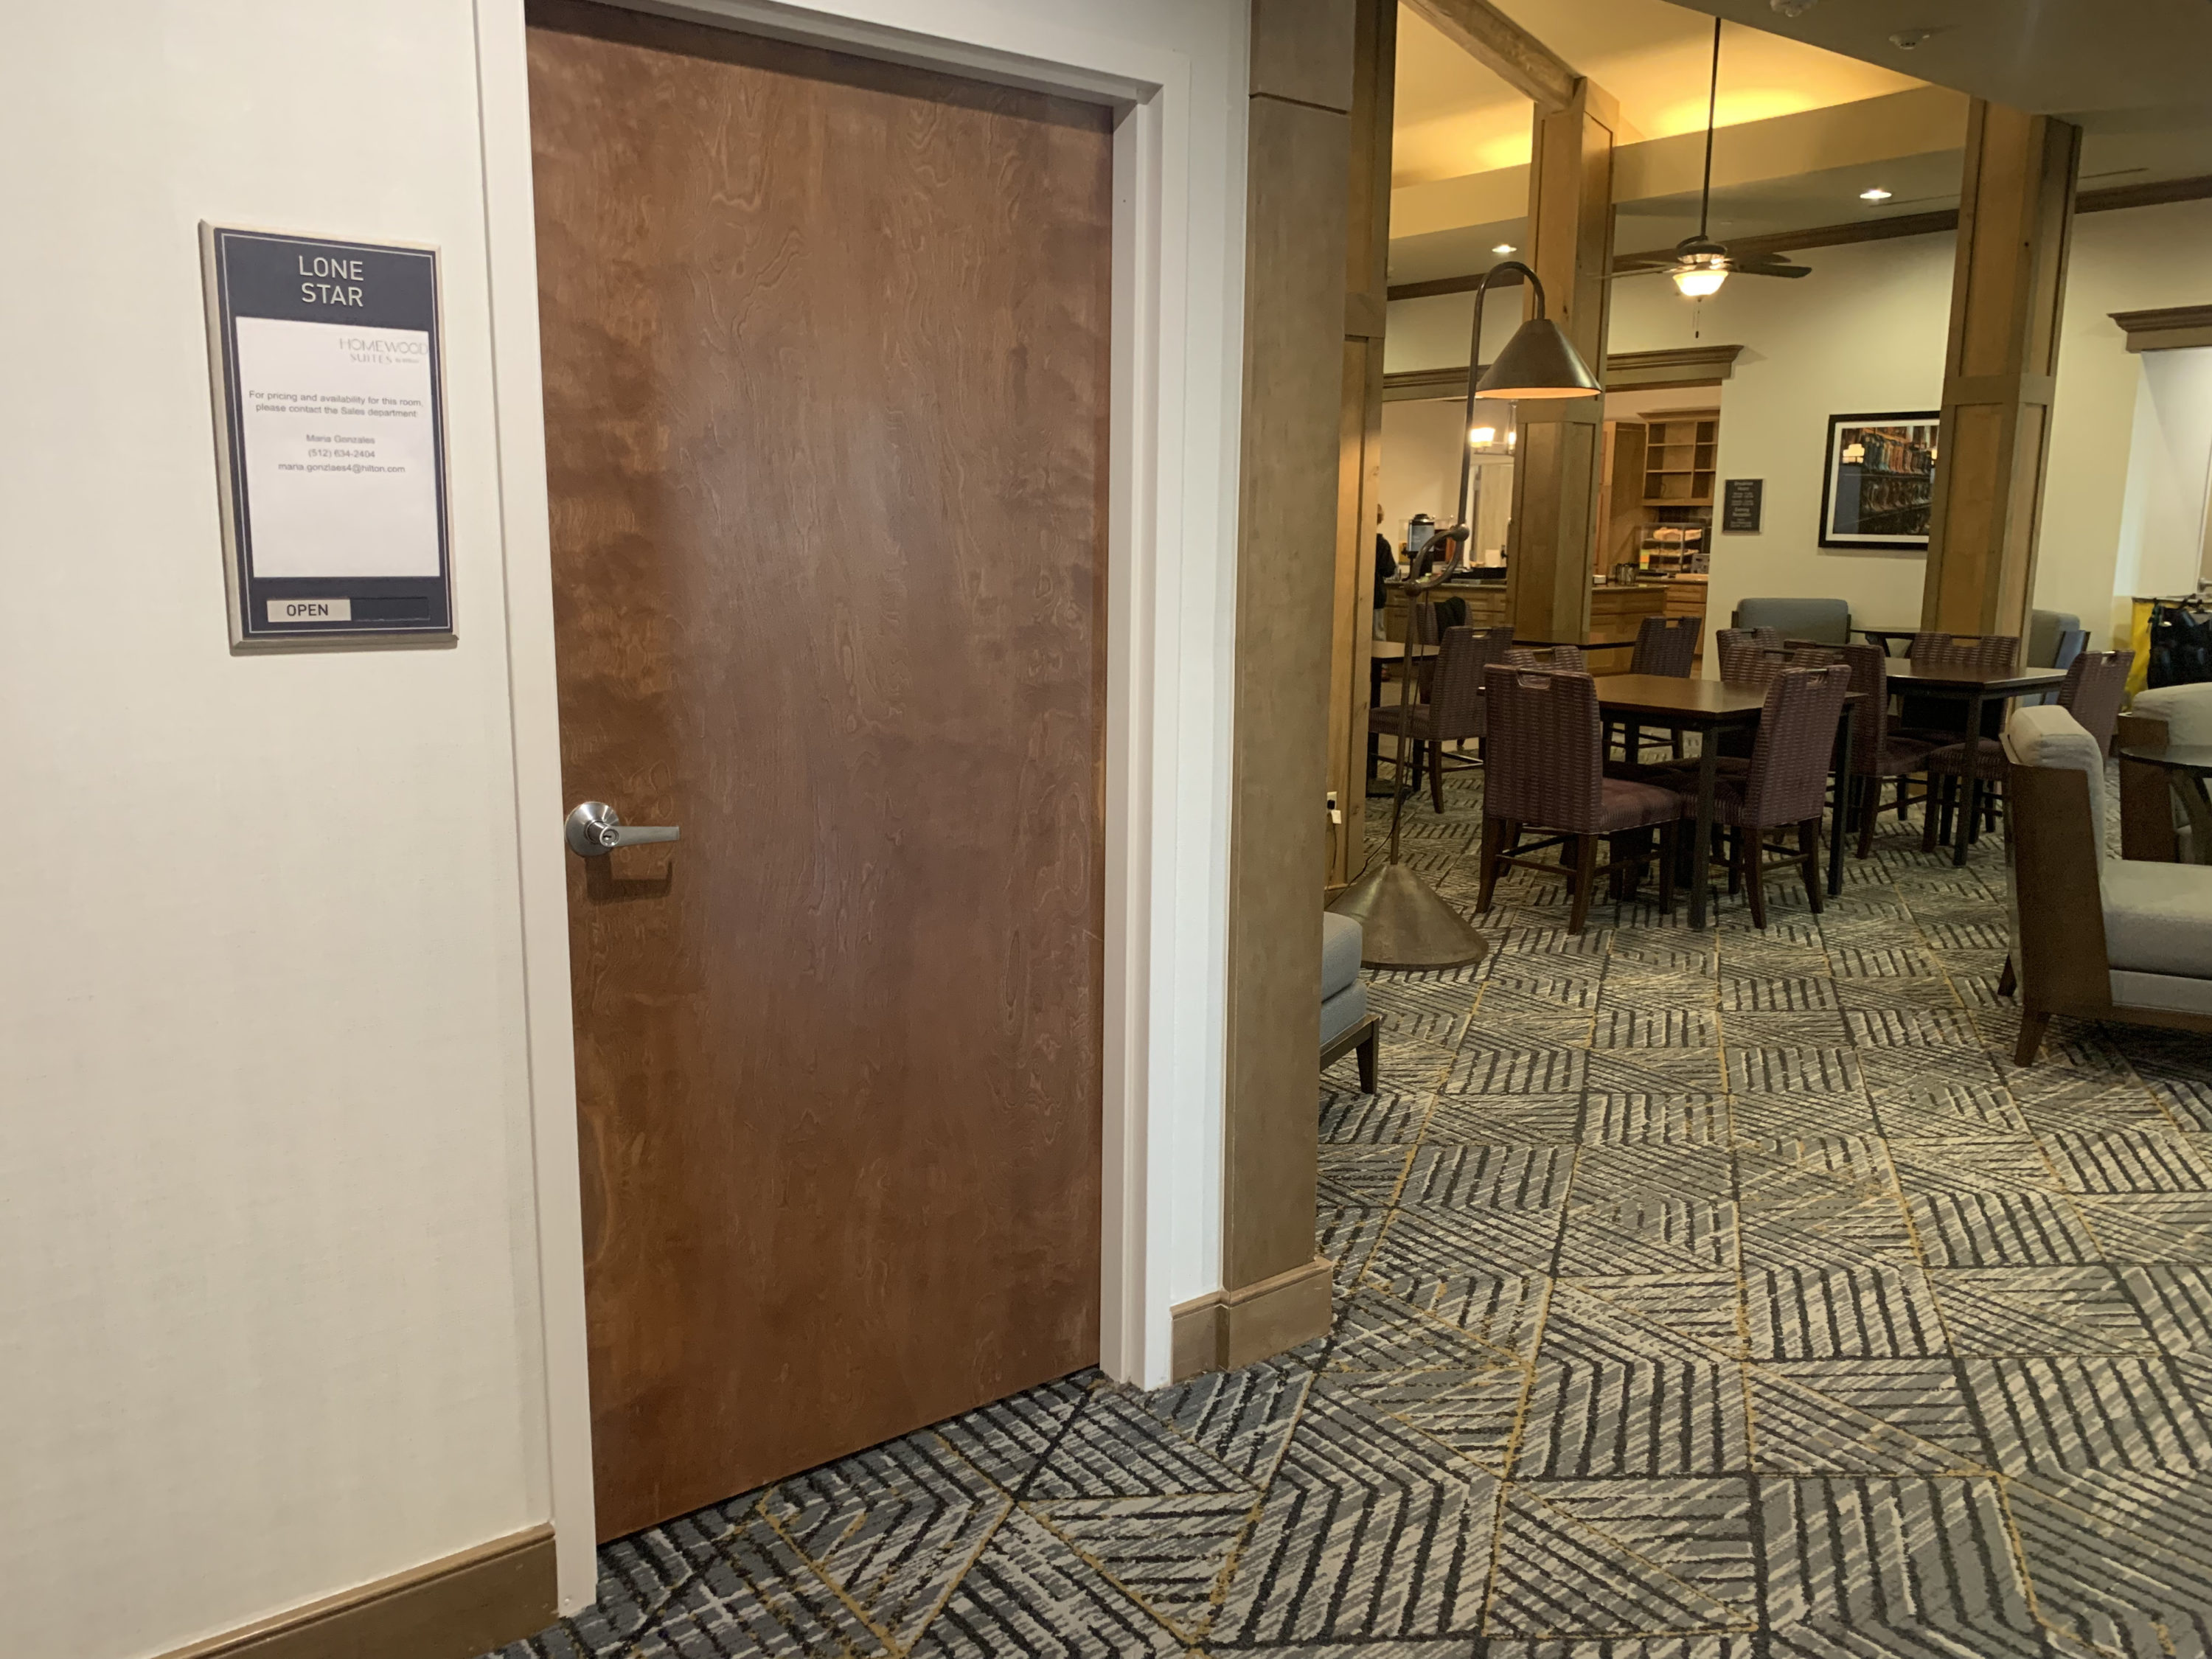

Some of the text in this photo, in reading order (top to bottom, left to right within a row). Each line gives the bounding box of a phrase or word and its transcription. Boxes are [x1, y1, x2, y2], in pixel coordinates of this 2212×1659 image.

[299, 254, 364, 282] LONE
[301, 282, 364, 307] STAR
[339, 338, 428, 355] HOMEWOOD
[349, 353, 392, 364] SUITES
[248, 390, 264, 399] For
[267, 392, 297, 403] pricing
[300, 394, 317, 402] and
[320, 395, 365, 406] availability
[367, 397, 379, 405] for
[382, 397, 397, 406] this
[255, 403, 286, 413] please
[288, 406, 321, 414] contact
[324, 406, 338, 414] the
[341, 406, 365, 415] Sales
[305, 434, 375, 445] Maria Gonzales
[307, 448, 332, 459] (512)
[286, 604, 329, 616] OPEN
